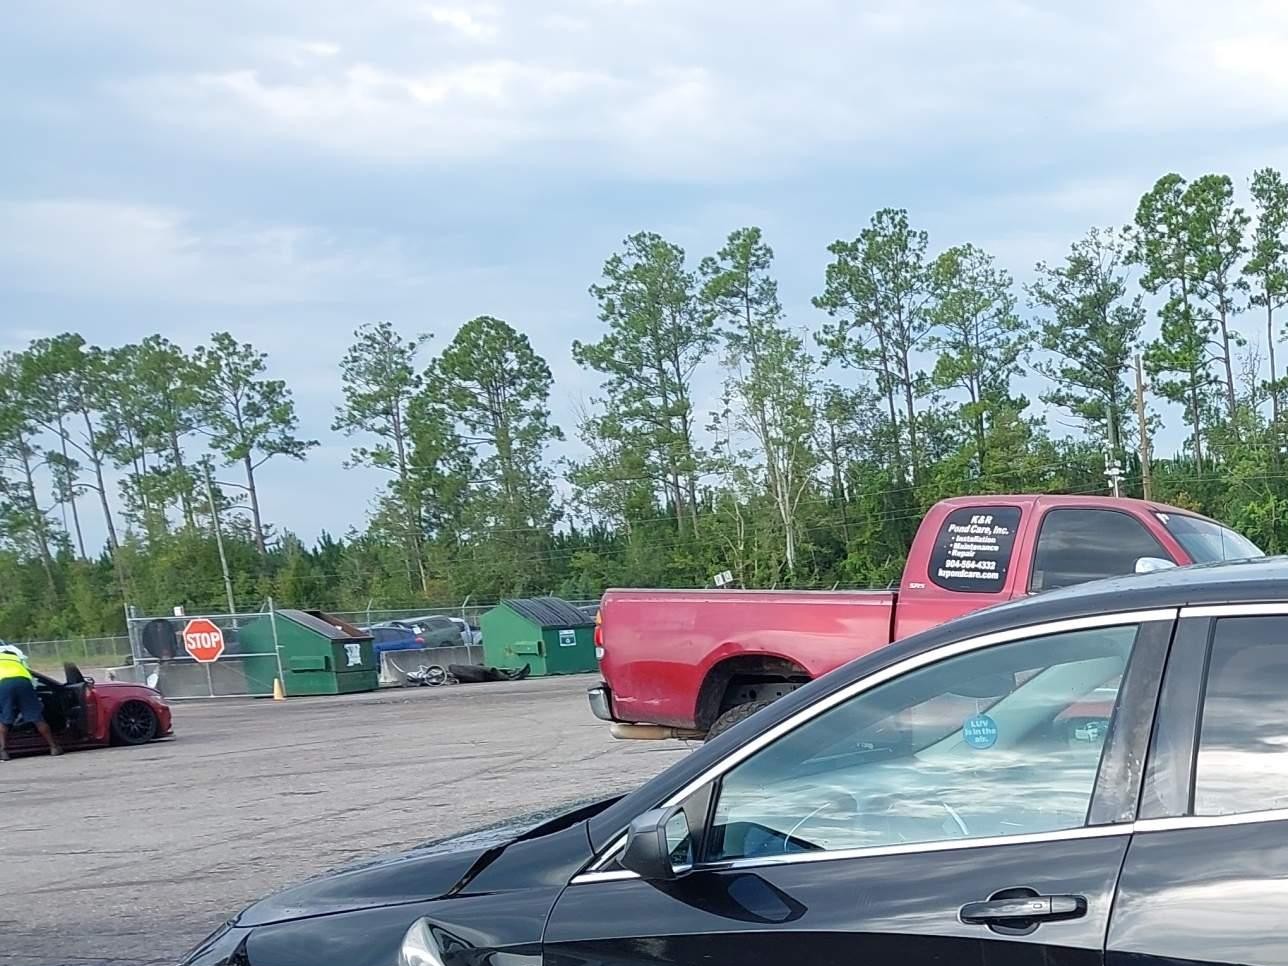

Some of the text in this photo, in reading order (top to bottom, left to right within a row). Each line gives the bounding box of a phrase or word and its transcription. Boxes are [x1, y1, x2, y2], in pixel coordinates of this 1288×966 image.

[970, 515, 993, 524] K&R
[948, 524, 1009, 535] Pond Care, Inc.
[956, 535, 996, 543] Installation
[953, 543, 999, 551] Maintenance
[951, 549, 976, 558] Repair
[945, 560, 996, 570] 904-564-4332
[938, 568, 999, 579] krpondcare.com
[187, 631, 220, 649] STOP
[971, 720, 988, 728] LUV
